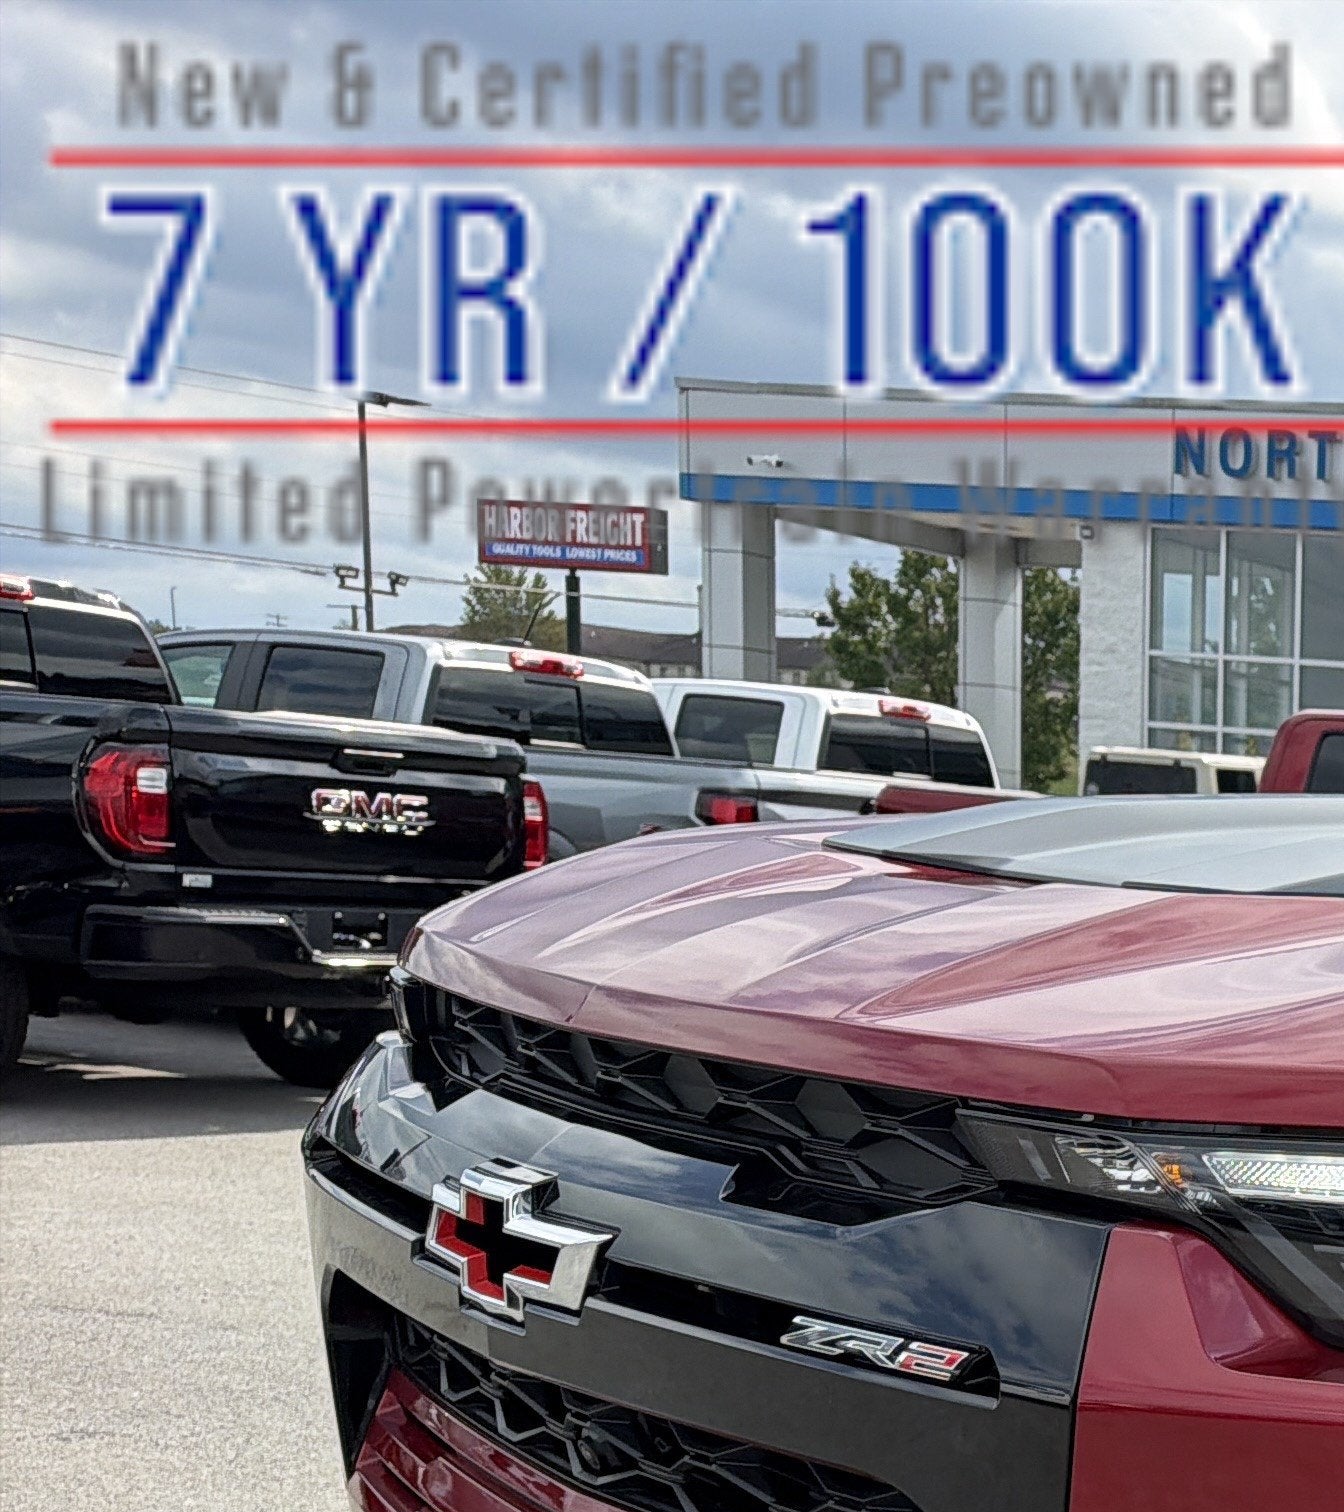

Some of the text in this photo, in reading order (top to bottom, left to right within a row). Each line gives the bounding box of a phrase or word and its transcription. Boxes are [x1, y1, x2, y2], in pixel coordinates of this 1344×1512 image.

[483, 504, 646, 548] HARBOR FREIGHT
[778, 1313, 974, 1383] ZR2
